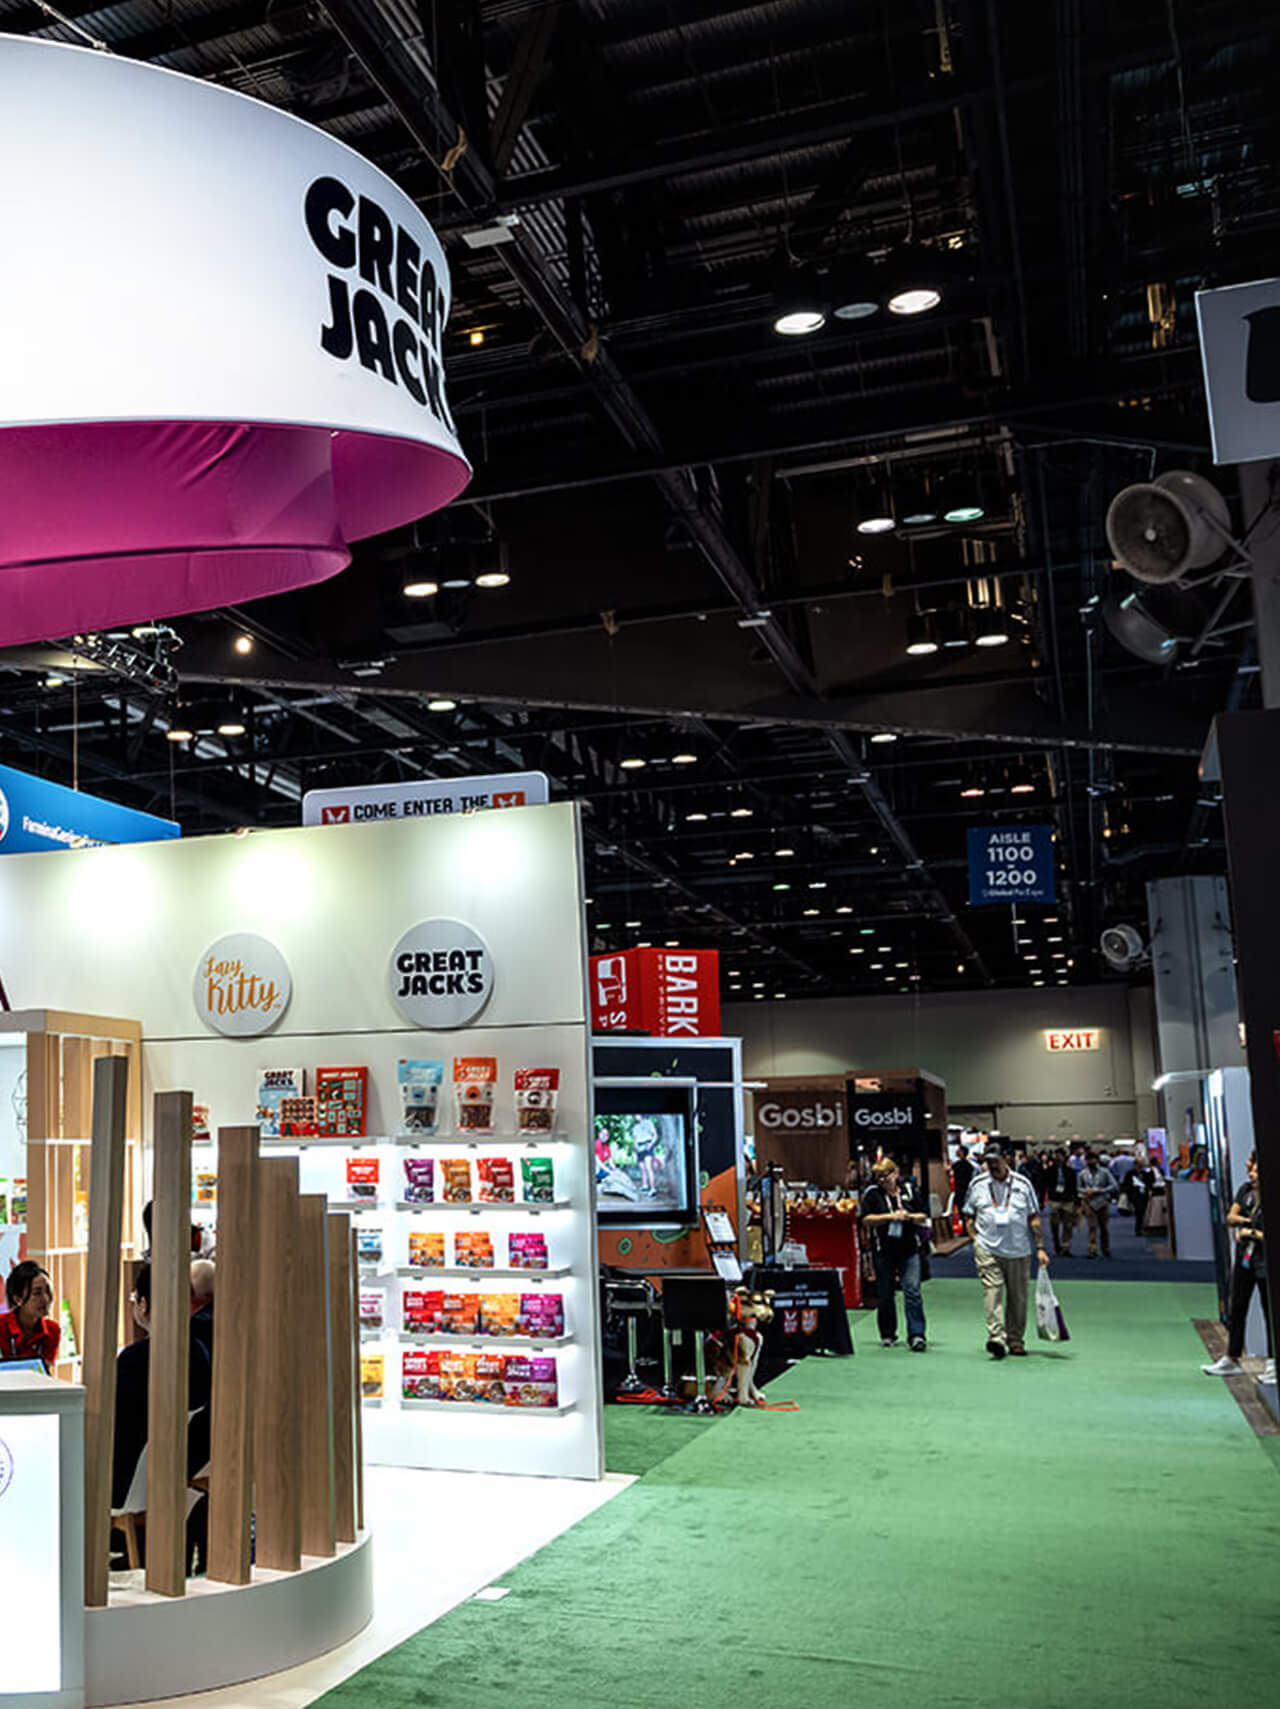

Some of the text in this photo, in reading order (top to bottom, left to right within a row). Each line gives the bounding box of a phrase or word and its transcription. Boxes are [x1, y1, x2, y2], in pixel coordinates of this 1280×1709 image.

[353, 802, 397, 820] COME
[403, 797, 453, 816] ENTER
[989, 832, 1032, 844] AISLE
[987, 846, 1034, 862] 1100
[986, 870, 1037, 886] 1200
[396, 949, 484, 975] GREAT
[397, 972, 484, 997] JACK'S
[664, 955, 700, 1036] BARK
[1049, 1032, 1096, 1049] EXIT
[758, 1102, 843, 1128] Gosbi
[854, 1106, 913, 1126] Gosbi
